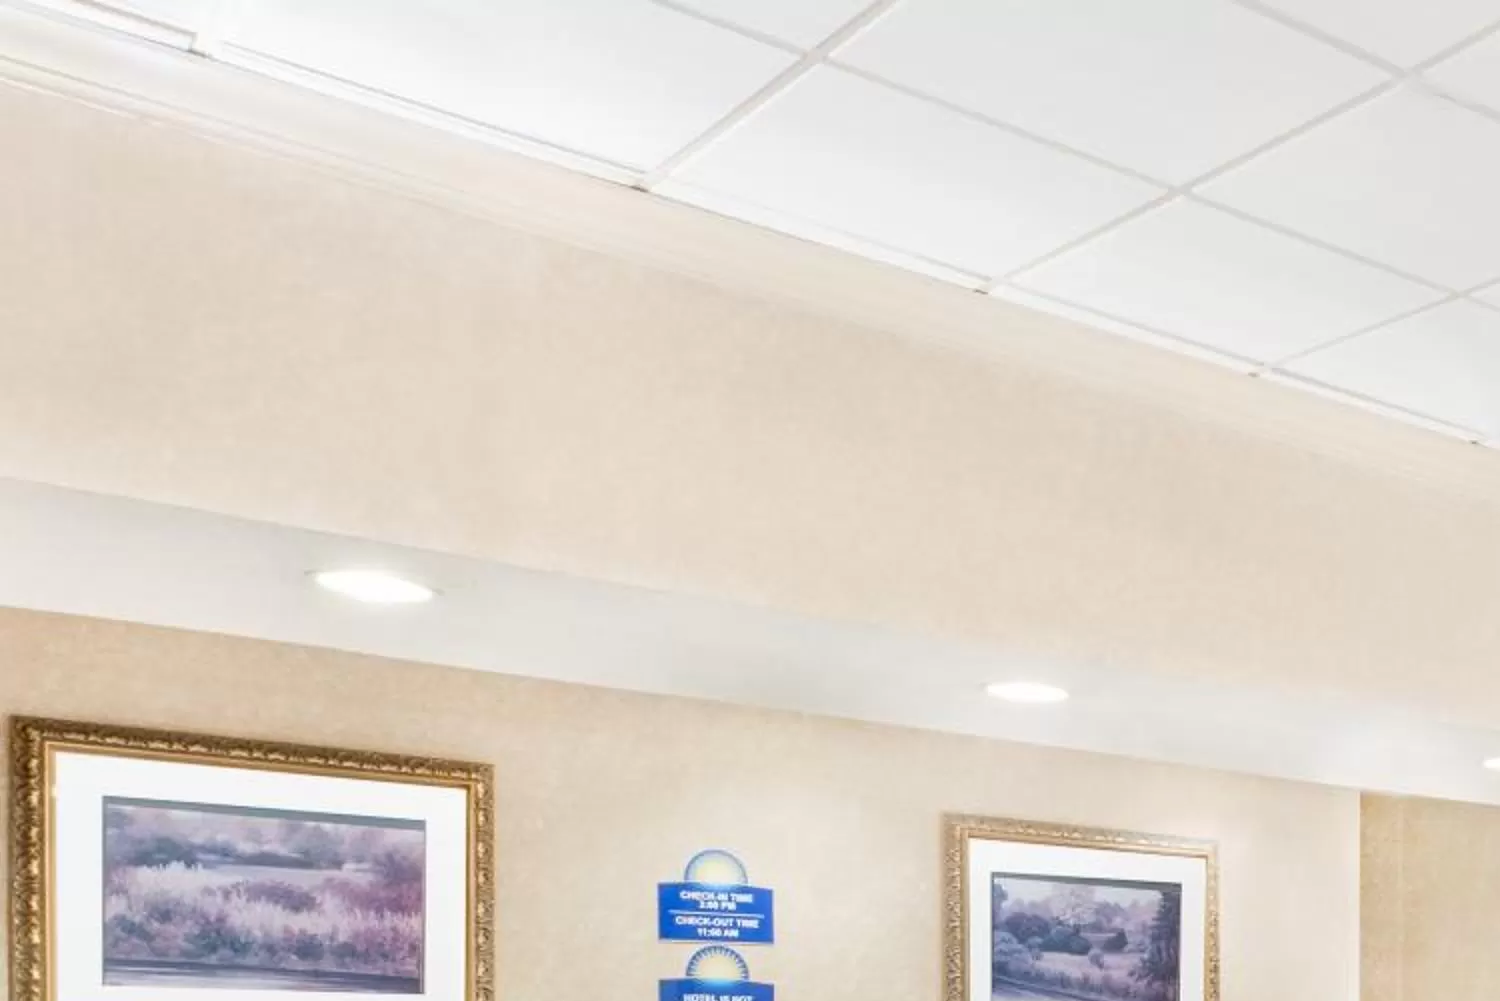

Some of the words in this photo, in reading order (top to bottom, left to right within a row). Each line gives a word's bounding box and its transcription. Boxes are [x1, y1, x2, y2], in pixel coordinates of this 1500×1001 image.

[730, 893, 753, 903] TIME
[675, 916, 734, 927] CHECK-OUT
[737, 918, 760, 929] TIME
